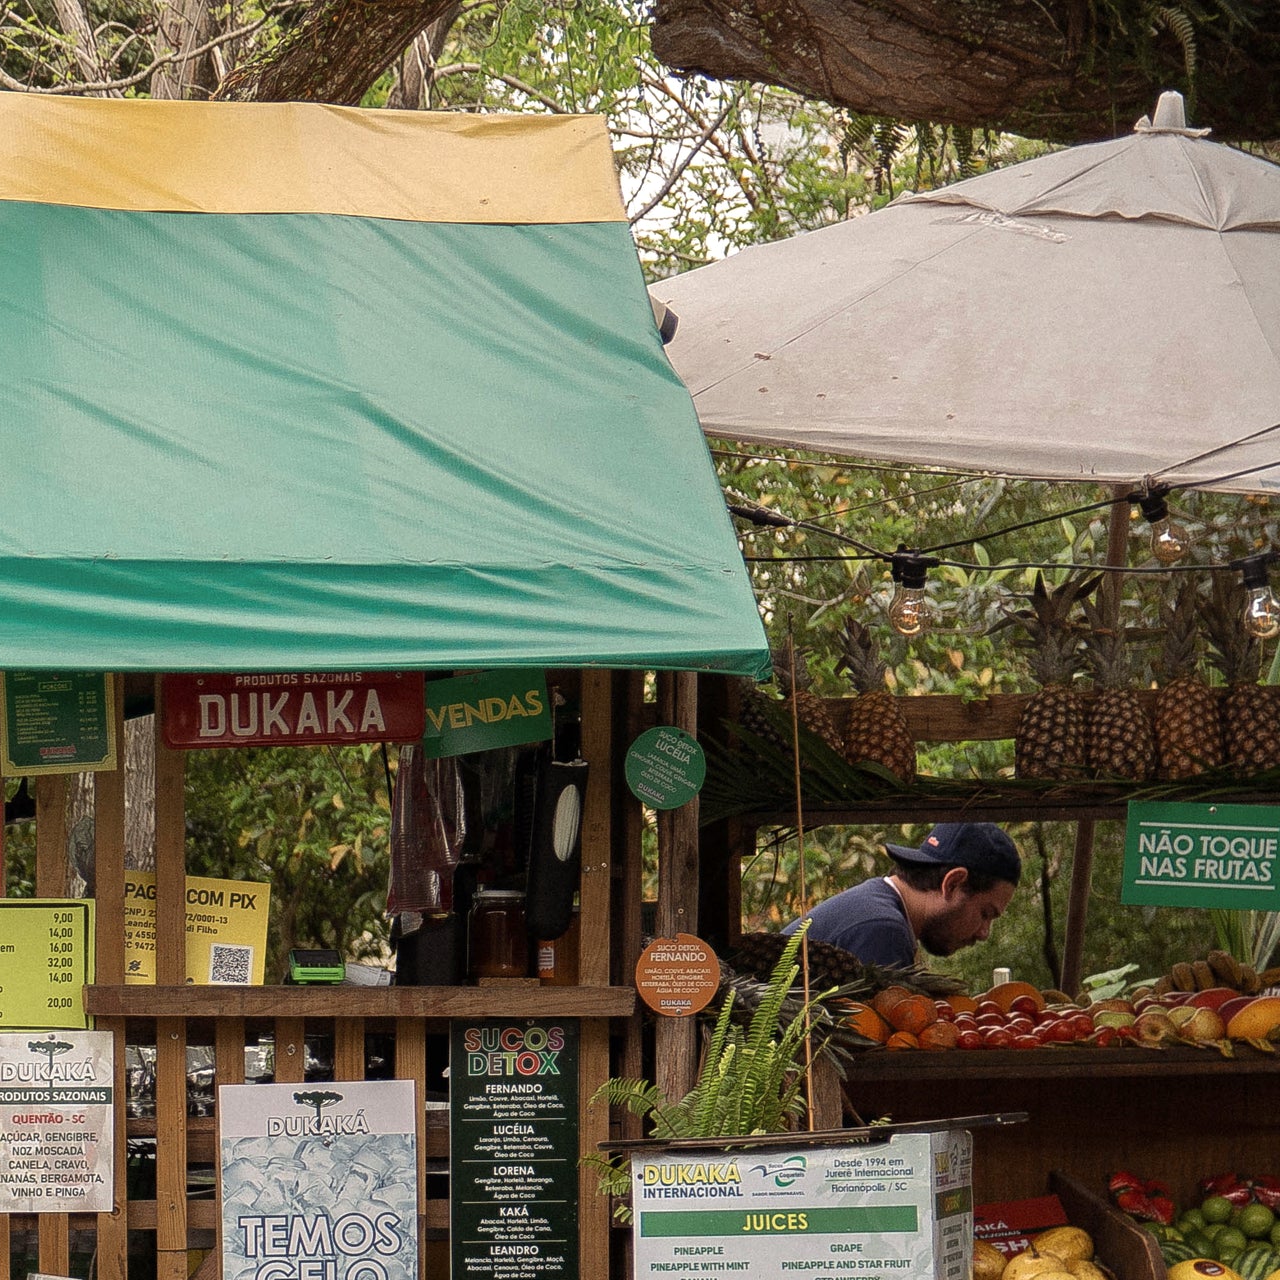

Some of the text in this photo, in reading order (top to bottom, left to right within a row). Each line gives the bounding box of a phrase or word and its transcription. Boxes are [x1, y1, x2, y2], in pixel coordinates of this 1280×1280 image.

[236, 672, 362, 686] PRODUTOS SAZONAIS
[198, 689, 386, 738] DUKAKA
[427, 690, 543, 732] VENDAS
[1139, 830, 1278, 859] NÃO TOQUE
[1140, 856, 1272, 882] NAS FRUTAS
[187, 889, 256, 909] COM PIX
[54, 913, 72, 924] 9,00
[50, 943, 72, 953] 16,00
[651, 952, 706, 961] FERNANDO
[464, 1027, 564, 1052] SUCOS
[1, 1056, 96, 1083] DUKAKÁ
[468, 1050, 560, 1076] DETOX
[53, 1092, 106, 1101] SAZONAIS
[486, 1084, 542, 1093] FERNANDO
[13, 1113, 63, 1125] QUENTÃO
[72, 1113, 85, 1123] SC
[267, 1108, 370, 1137] DUKAKÁ
[644, 1159, 740, 1186] DUKAKÁ
[644, 1186, 743, 1198] INTERNACIONAL
[743, 1214, 807, 1230] JUICES
[239, 1212, 402, 1257] TEMOS
[674, 1247, 724, 1255] PINEAPPLE
[831, 1244, 862, 1252] GRAPE
